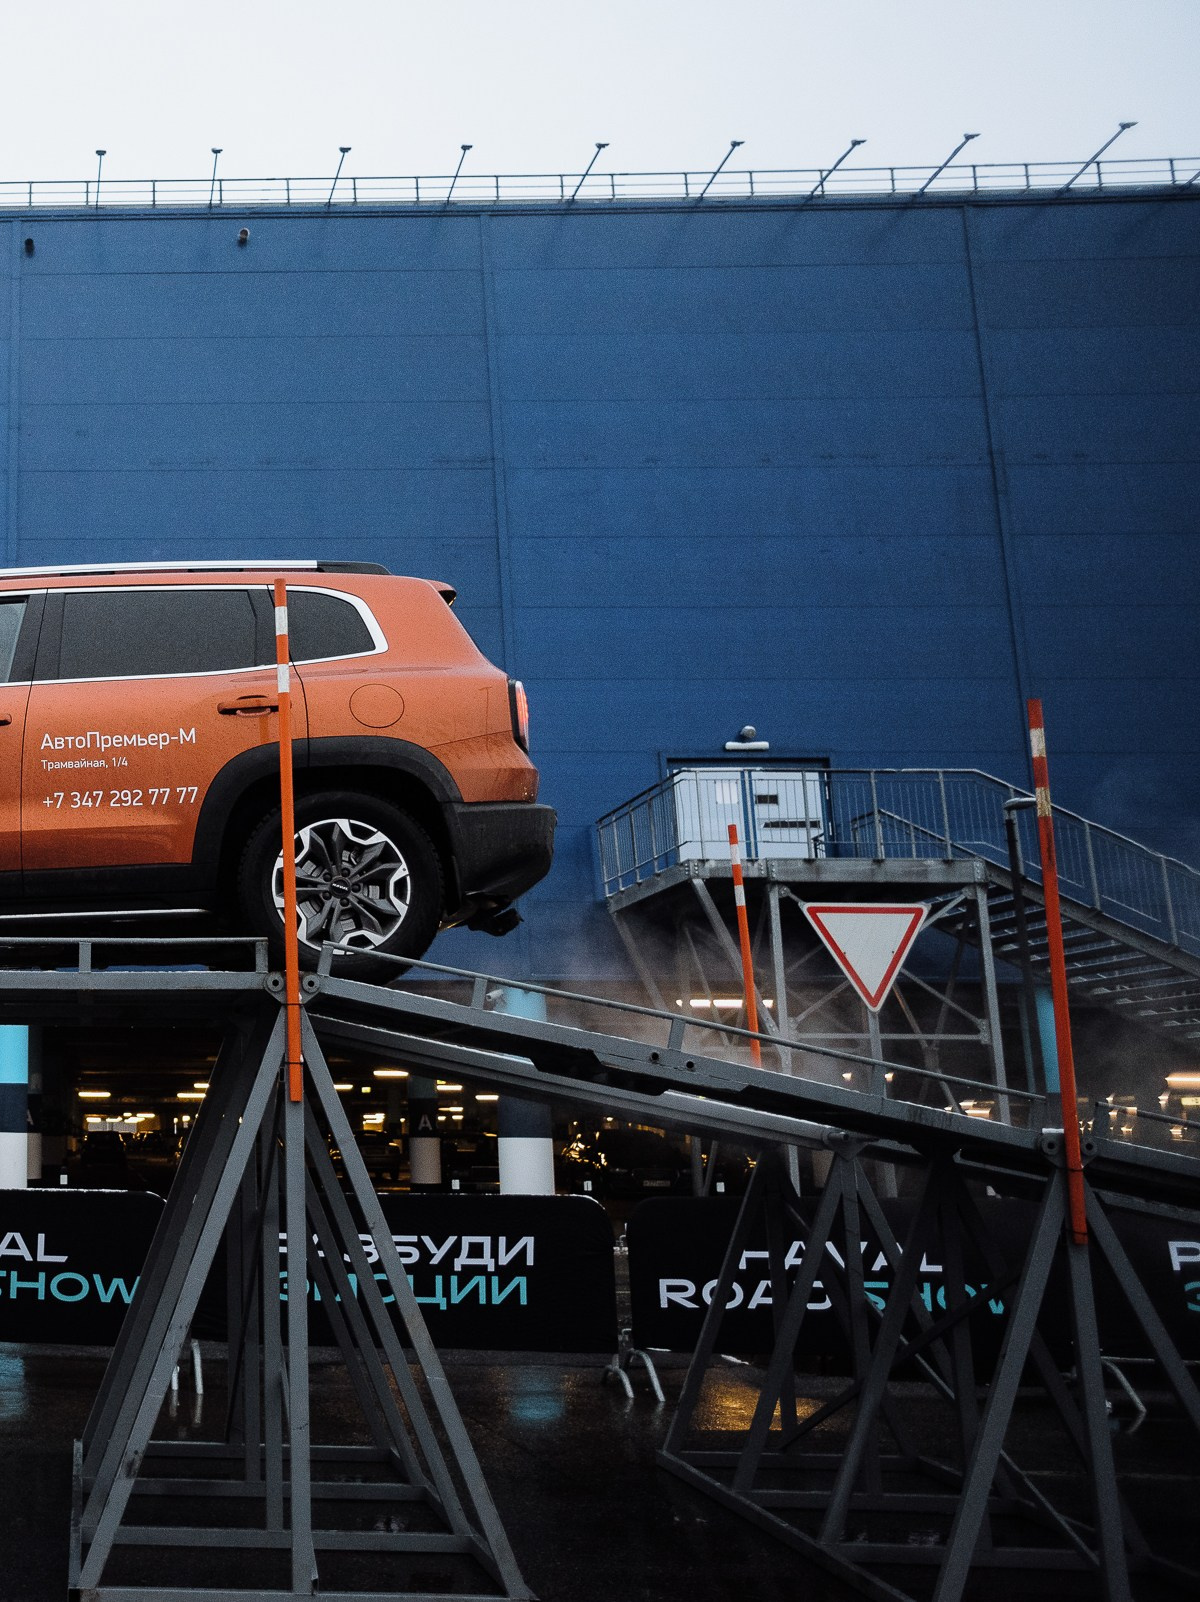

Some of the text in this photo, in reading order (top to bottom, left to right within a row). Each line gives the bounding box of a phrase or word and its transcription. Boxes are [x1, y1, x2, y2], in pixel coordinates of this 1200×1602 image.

[40, 727, 197, 752] АвтоПремьер-М
[41, 756, 129, 771] Трамвайная, 1/4
[42, 786, 199, 808] +7 347 292 77 77
[279, 1233, 535, 1271] ЗБУДИ
